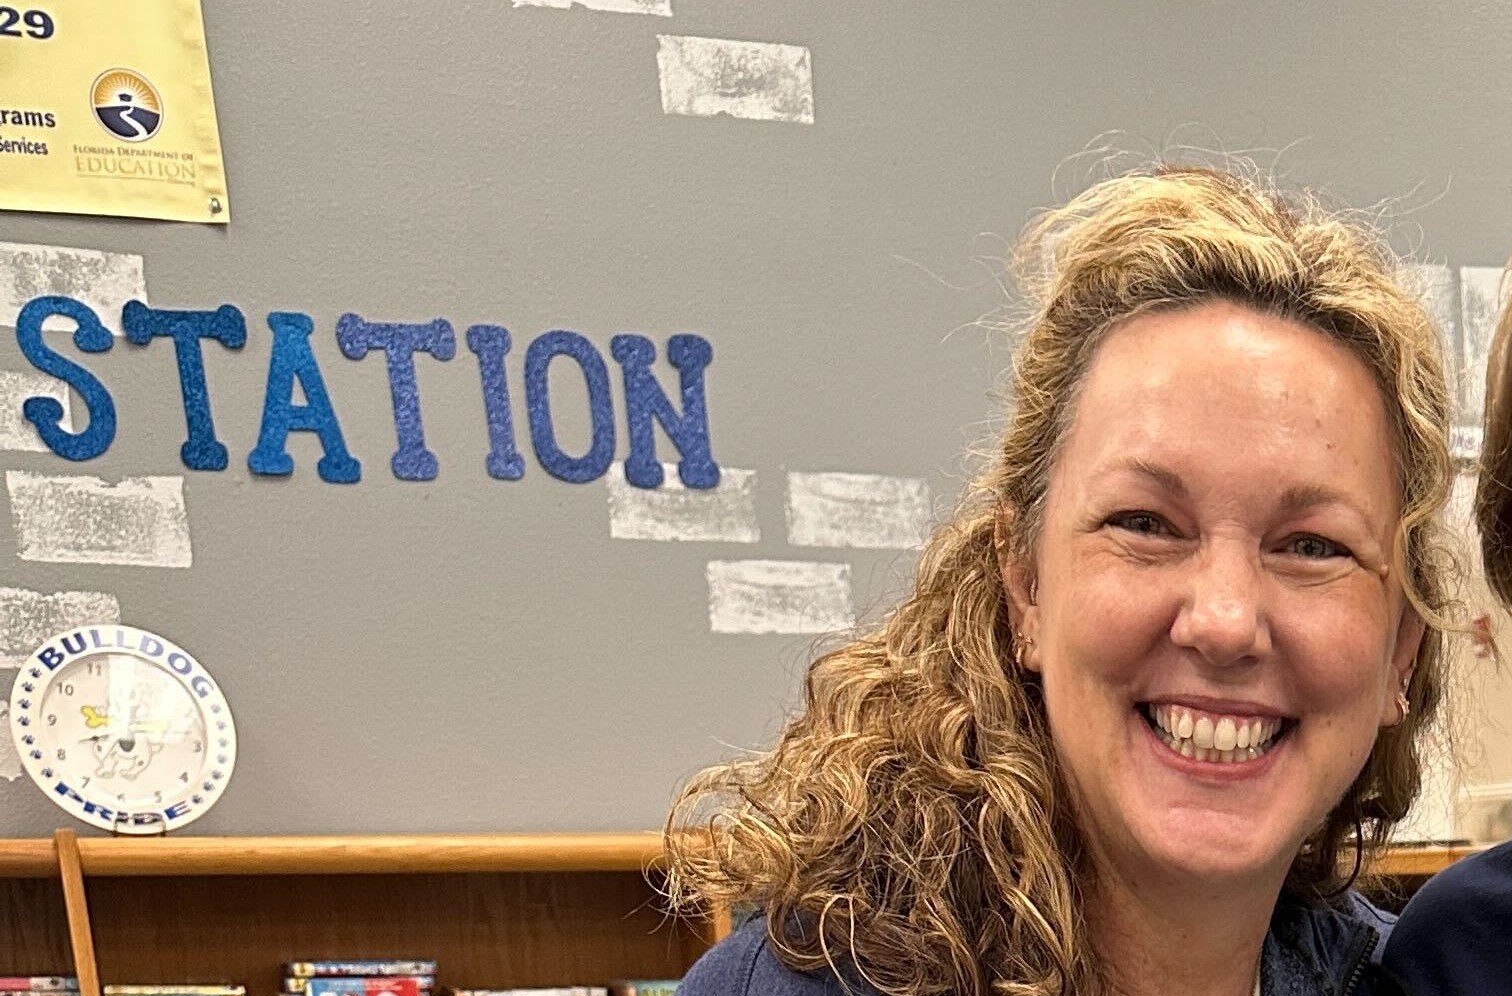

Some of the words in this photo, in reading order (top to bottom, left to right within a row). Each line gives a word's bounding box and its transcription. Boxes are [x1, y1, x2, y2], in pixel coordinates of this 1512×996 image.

[0, 6, 55, 40] 29
[73, 144, 115, 155] FLORIDA
[117, 146, 179, 160] DEPARTMENT
[75, 156, 197, 179] EDUCATION
[16, 295, 721, 490] STATION
[37, 628, 215, 699] BULLDOG
